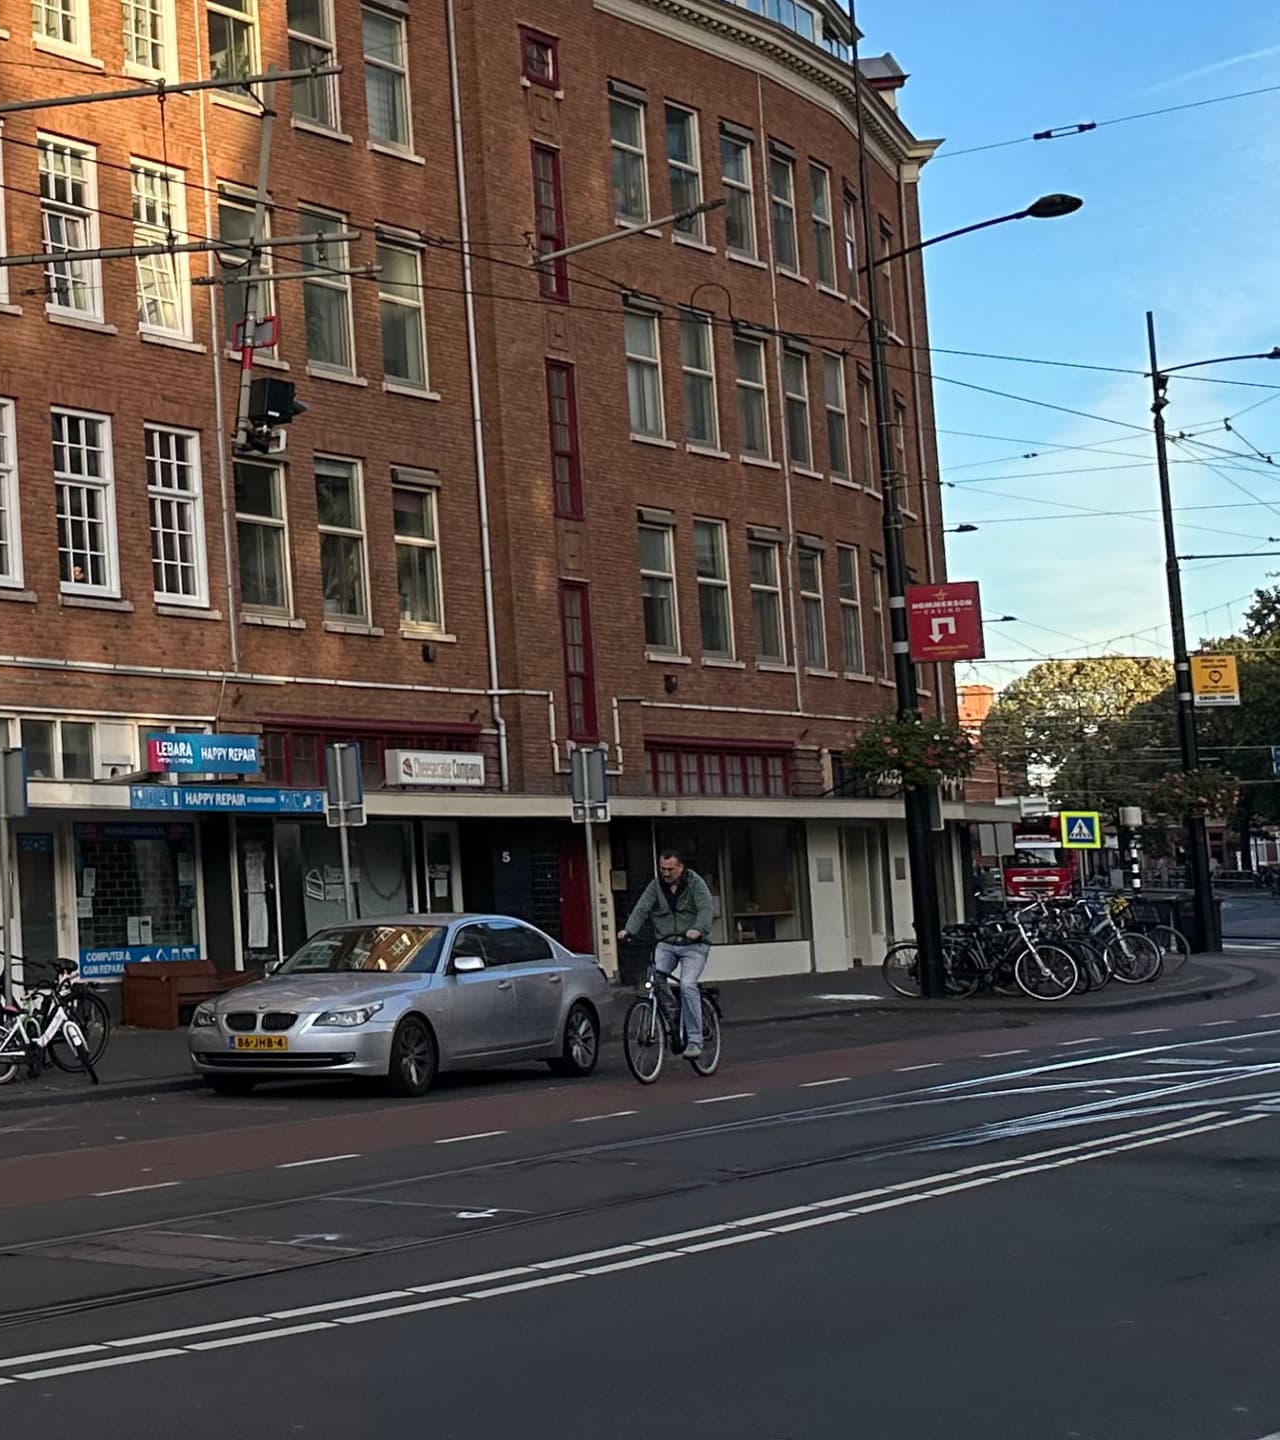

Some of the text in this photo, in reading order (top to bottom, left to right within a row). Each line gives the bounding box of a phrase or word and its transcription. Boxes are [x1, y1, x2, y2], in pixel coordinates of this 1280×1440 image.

[912, 599, 972, 610] HOMMERSON
[156, 741, 192, 757] LEBARA
[200, 747, 256, 762] HAPPY REPAIR
[185, 791, 214, 806] HAPPY
[215, 792, 246, 807] REPAIR
[86, 951, 124, 962] COMPUTER
